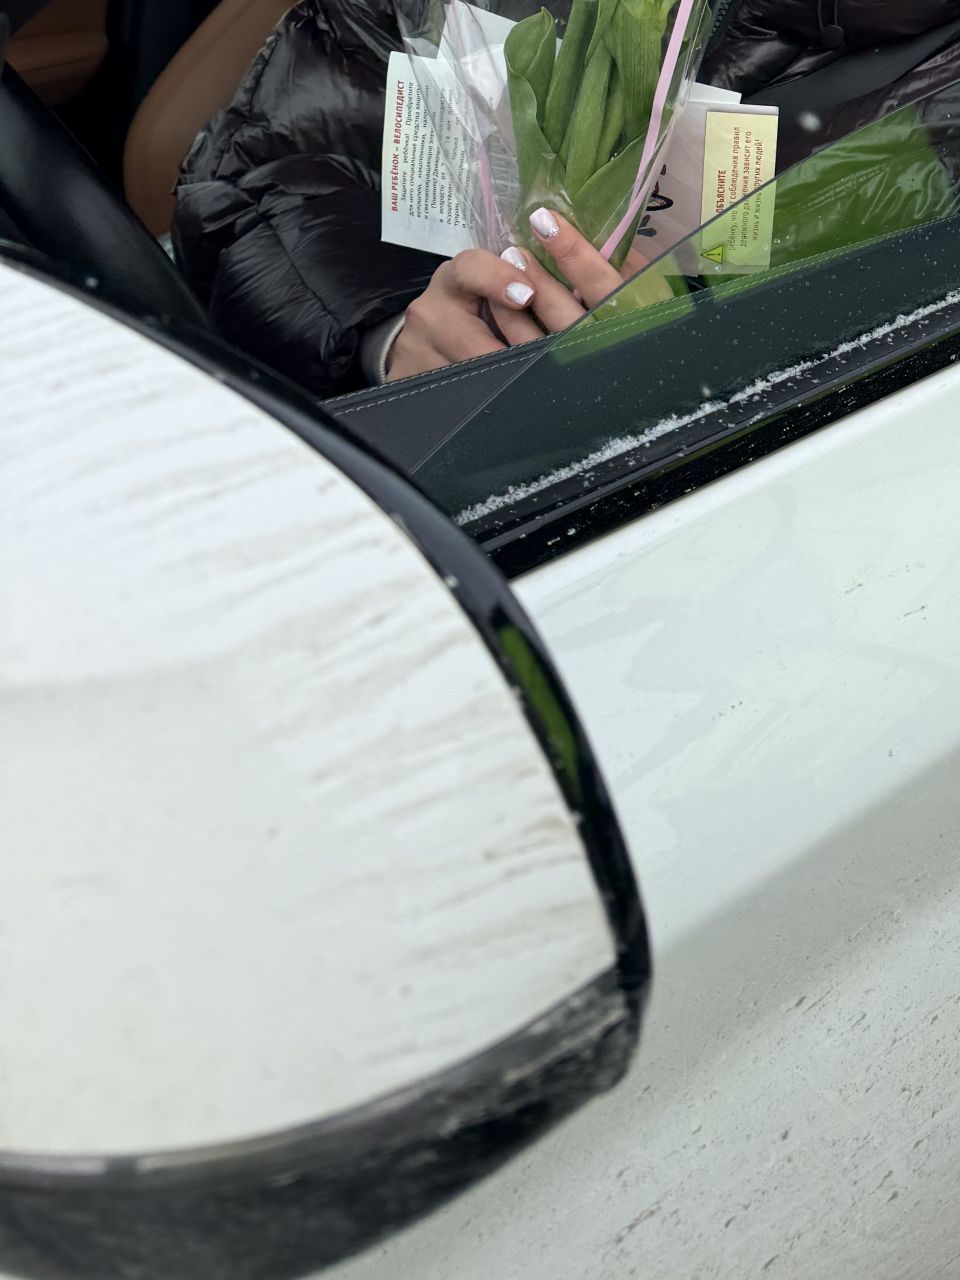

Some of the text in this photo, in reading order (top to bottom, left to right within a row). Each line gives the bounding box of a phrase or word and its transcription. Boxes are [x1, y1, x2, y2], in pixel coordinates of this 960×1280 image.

[393, 80, 404, 144] ВЕЛОСИПЕДИСТ
[405, 82, 414, 125] Приобретите
[732, 127, 740, 154] правил
[755, 139, 764, 165] людей!
[390, 153, 399, 190] РЕБЁНОК
[441, 172, 446, 180] от
[729, 156, 739, 199] соблюдения
[743, 145, 751, 174] зависит
[715, 170, 726, 214] ОБЪЯСНИТЕ
